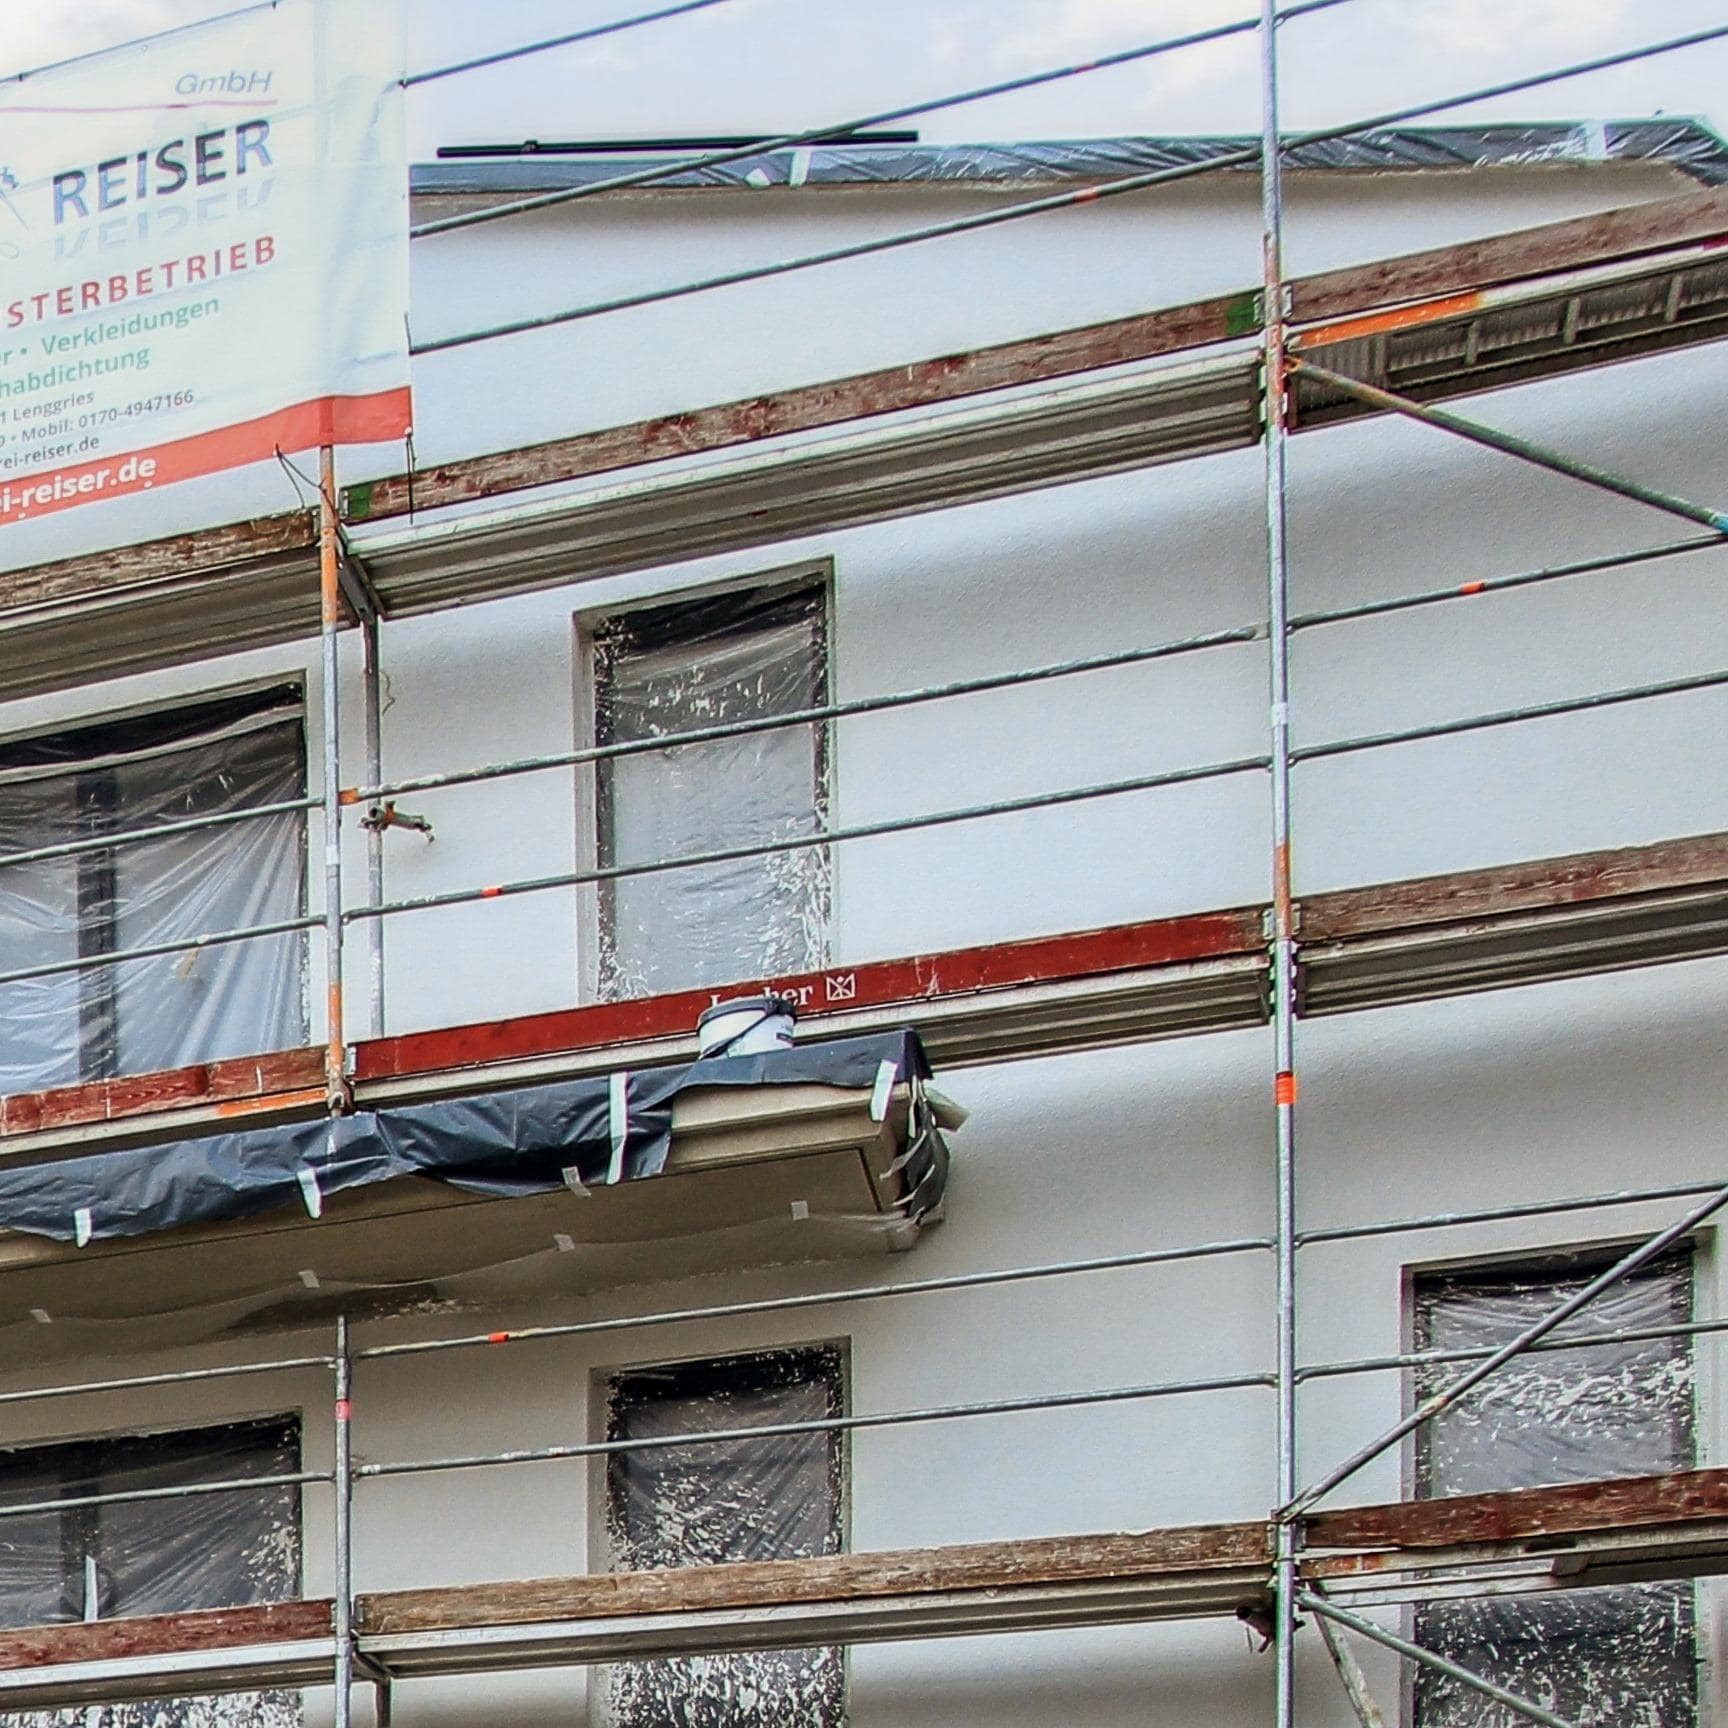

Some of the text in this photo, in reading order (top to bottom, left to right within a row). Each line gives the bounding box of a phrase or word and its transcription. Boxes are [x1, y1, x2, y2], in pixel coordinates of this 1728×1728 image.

[174, 71, 274, 96] GmbH
[52, 119, 274, 226] REISER
[41, 297, 220, 356] Verkleidungen
[12, 389, 96, 422] Lenggries
[21, 419, 75, 444] Mobil:
[78, 388, 194, 430] 0170-4947166
